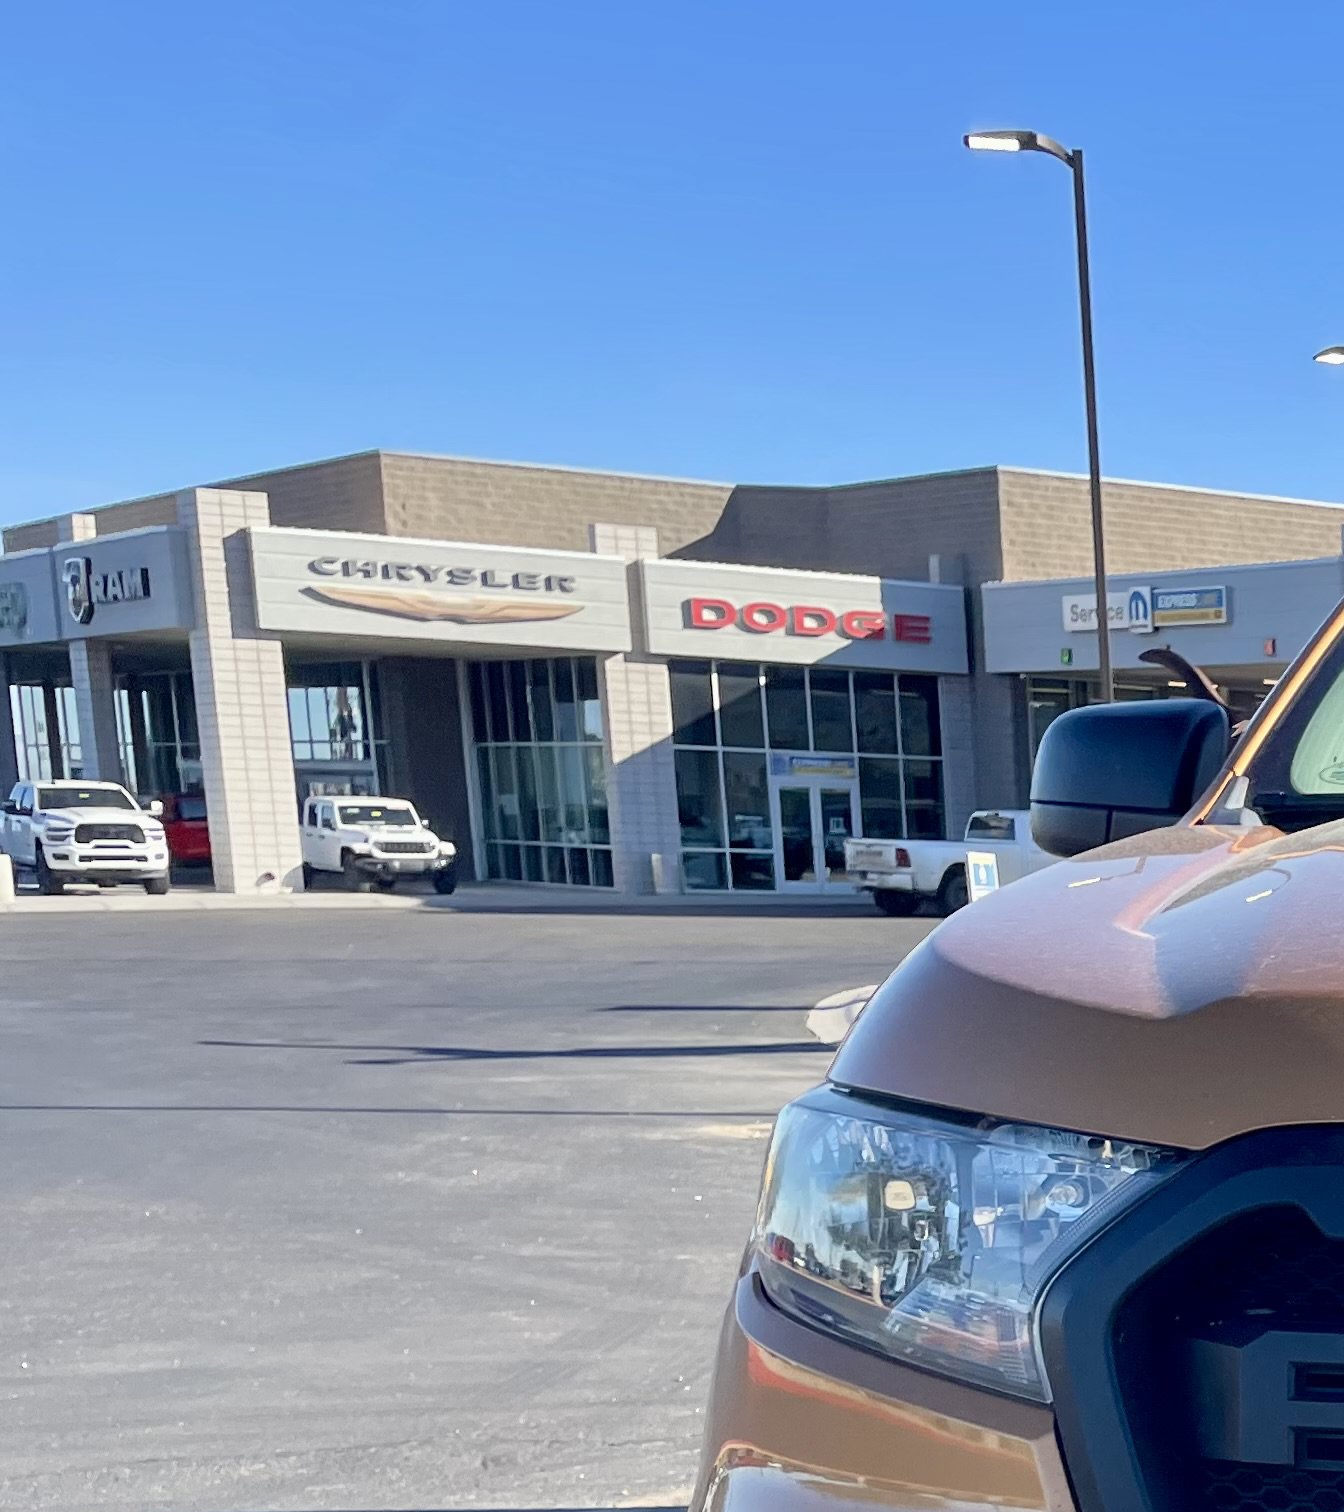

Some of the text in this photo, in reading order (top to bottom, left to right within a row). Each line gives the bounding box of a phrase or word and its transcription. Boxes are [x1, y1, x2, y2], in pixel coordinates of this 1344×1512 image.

[91, 567, 151, 604] RAM
[307, 556, 576, 593] CHRYSLER
[681, 597, 932, 644] DODGE
[1070, 604, 1124, 623] Serce
